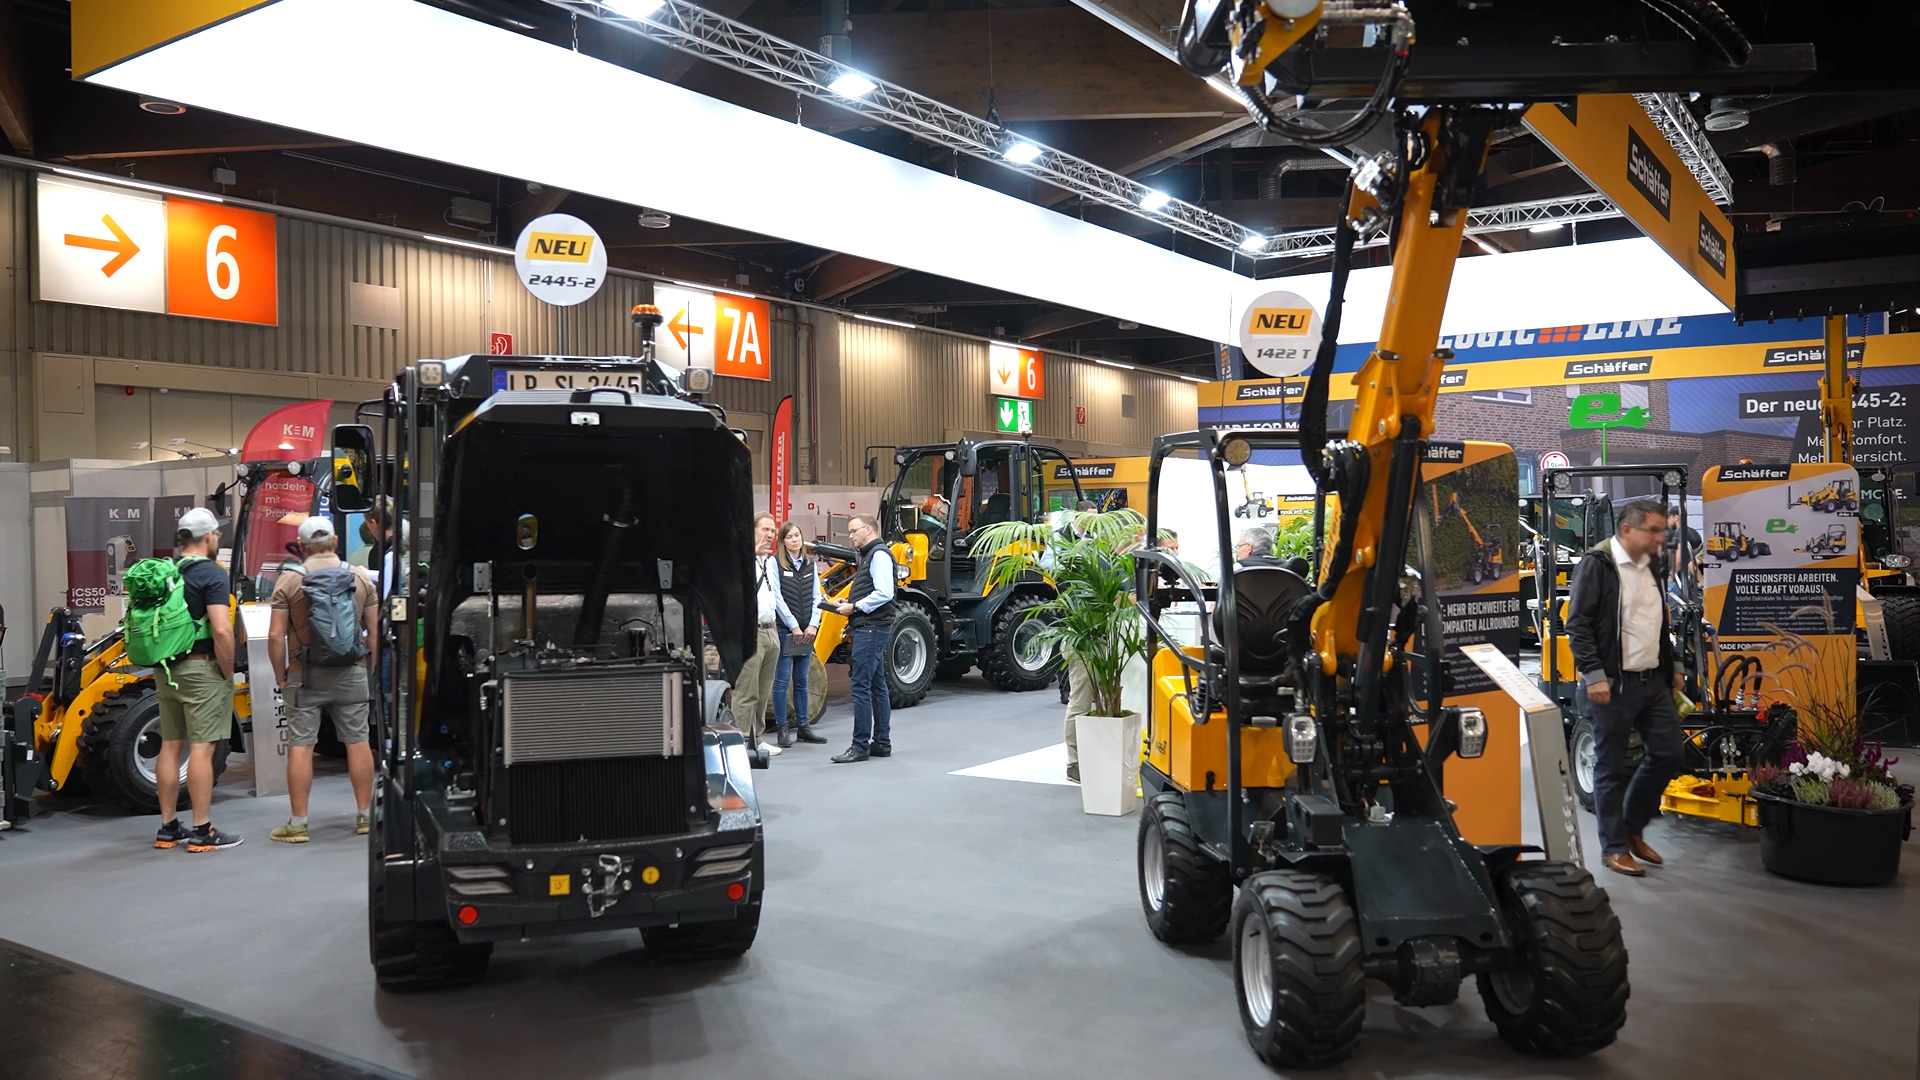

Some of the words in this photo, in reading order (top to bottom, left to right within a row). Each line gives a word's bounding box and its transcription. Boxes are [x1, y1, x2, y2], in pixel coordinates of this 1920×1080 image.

[1629, 143, 1669, 208] Schäffer
[534, 238, 587, 257] NEU
[1700, 223, 1726, 269] Schäffer
[205, 224, 241, 300] 6
[528, 274, 597, 289] 2445-2
[1256, 313, 1305, 329] NEU
[1583, 316, 1683, 341] LINE
[723, 306, 763, 366] 7A
[1256, 347, 1298, 359] 1422
[1302, 349, 1312, 359] T
[1768, 348, 1862, 364] Schär
[1026, 357, 1036, 391] 6
[1568, 361, 1648, 376] Schäffer
[1240, 386, 1302, 398] Schäfer
[1746, 399, 1779, 414] Der
[1852, 391, 1907, 409] 45-2:
[1868, 416, 1907, 428] Platz.
[1852, 450, 1907, 463] ersicht.
[1721, 468, 1787, 479] Schäffer
[265, 495, 281, 504] mit
[1735, 573, 1796, 583] EMISSIONSFREI
[1797, 572, 1839, 583] ARBEITEN.
[71, 587, 107, 598] iCS50
[1735, 585, 1760, 595] VOLLE
[1761, 584, 1787, 594] KRAFT
[1788, 584, 1824, 594] VORAUS!
[1447, 603, 1467, 617] MEHR
[1467, 600, 1507, 616] REICHWEITE
[1507, 597, 1520, 613] FÜR
[1478, 615, 1520, 632] ALLROUNDER
